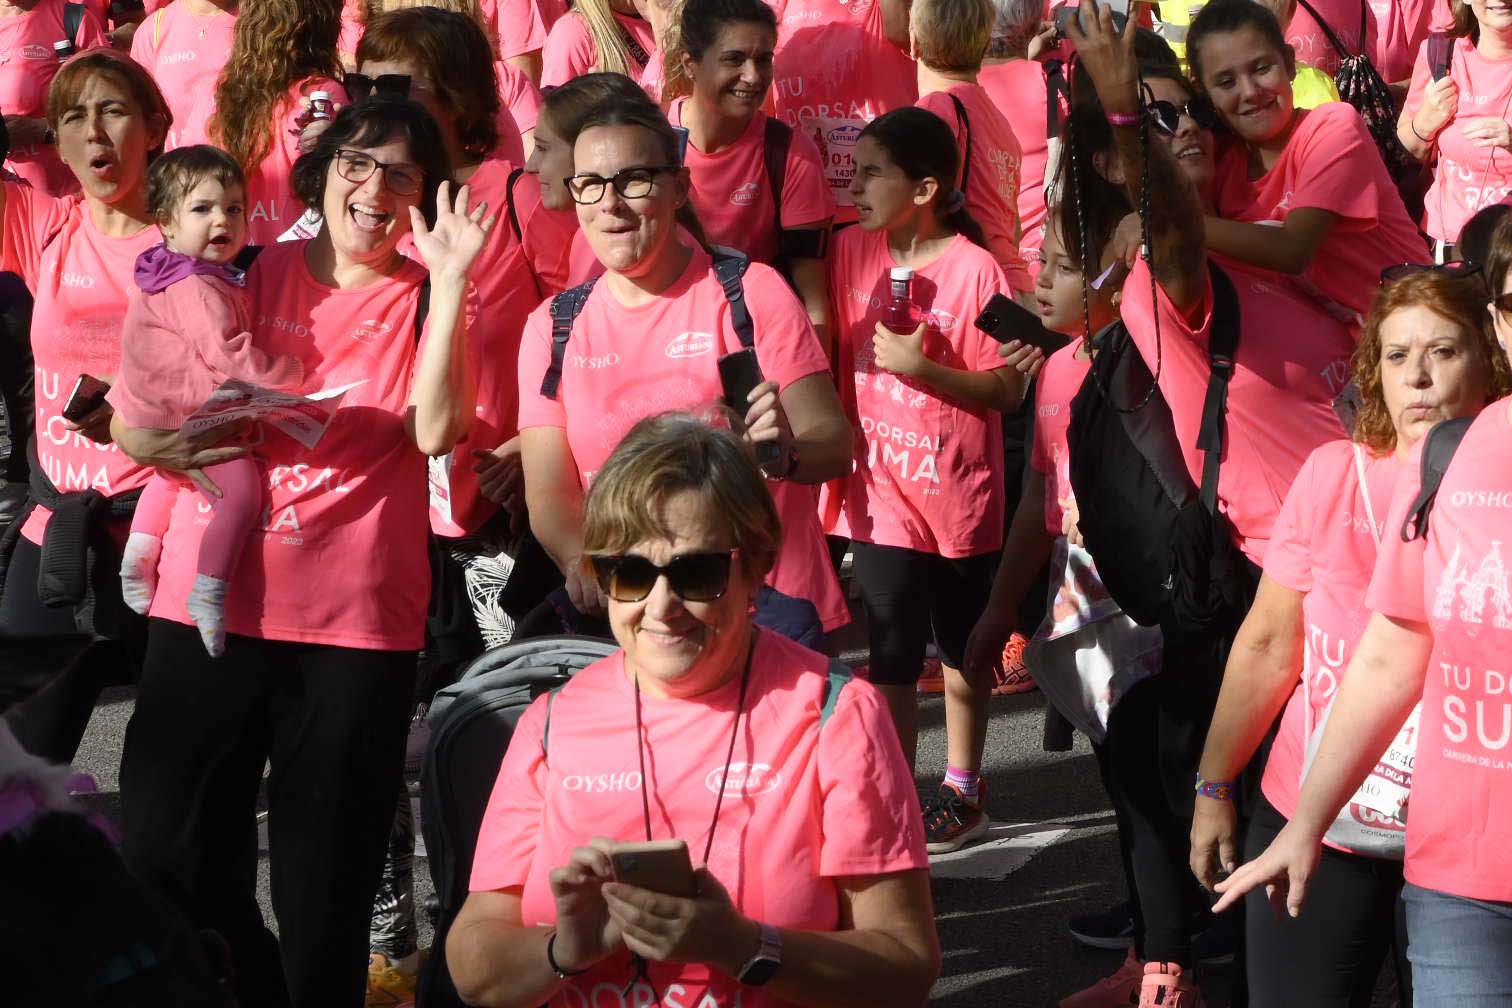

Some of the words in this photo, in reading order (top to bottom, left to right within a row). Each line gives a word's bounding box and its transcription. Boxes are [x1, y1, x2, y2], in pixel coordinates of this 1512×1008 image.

[780, 76, 804, 98] TU
[785, 98, 875, 129] DORSAL
[1440, 661, 1471, 691] TU
[1478, 756, 1490, 767] DE
[1492, 758, 1505, 769] LA
[562, 770, 643, 793] OYSHO
